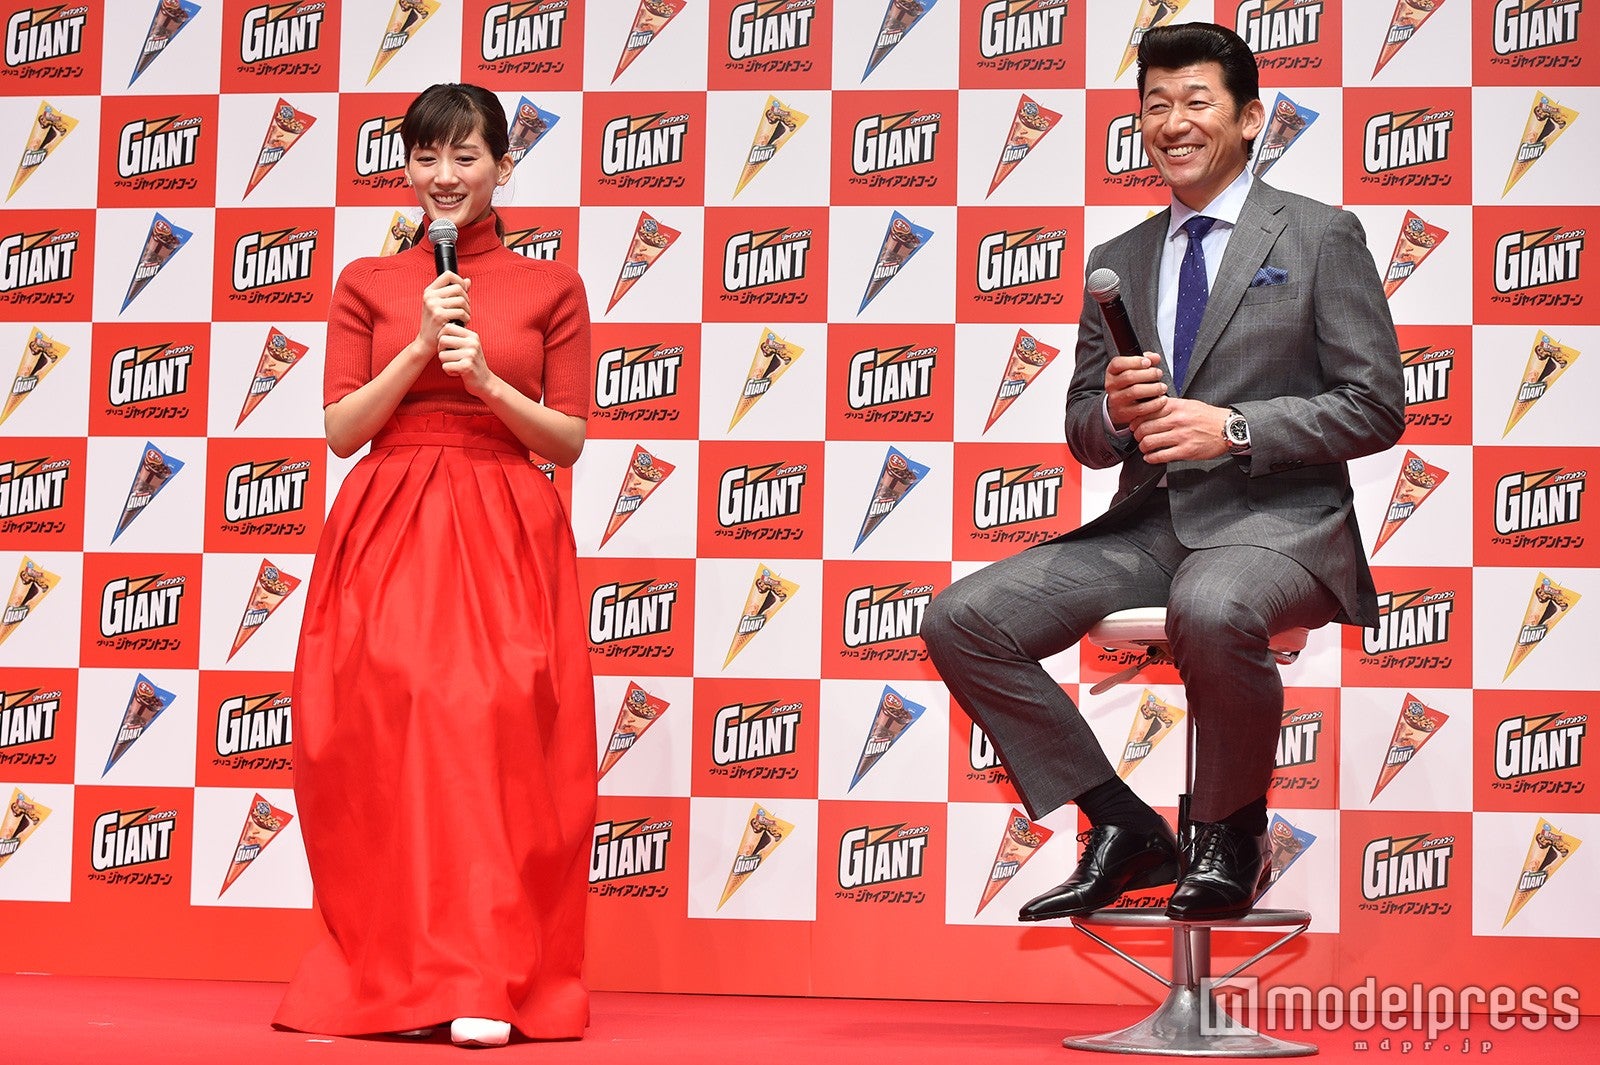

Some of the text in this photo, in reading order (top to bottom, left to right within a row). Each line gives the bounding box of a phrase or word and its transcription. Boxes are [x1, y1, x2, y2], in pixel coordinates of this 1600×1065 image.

[6, 10, 85, 66] GIANT
[242, 6, 322, 63] GIANT
[482, 4, 565, 60] GIANT
[730, 2, 813, 59] GIANT
[981, 0, 1066, 58] GIANT
[1494, 0, 1580, 54] GIANT
[20, 67, 83, 79] ジャイアントコーン
[256, 64, 321, 76] ジャイアントコーン
[498, 62, 564, 74] ジャイアントコーン
[745, 60, 812, 72] ジャイアントコーン
[997, 59, 1066, 71] ジャイアントコーン
[1511, 55, 1581, 68] ジャイアントコーン
[118, 121, 199, 177] GIANT
[357, 119, 406, 176] GIA
[602, 117, 686, 175] GIANT
[853, 116, 938, 174] GIANT
[1365, 114, 1451, 173] GIANT
[133, 178, 197, 190] ジャイアントコーン
[618, 176, 685, 188] ジャイアントコーン
[869, 175, 937, 188] ジャイアントコーン
[1381, 174, 1451, 186] ジャイアントコーン
[0, 235, 76, 292] GIANT
[233, 233, 315, 290] GIANT
[724, 233, 809, 291] GIANT
[978, 233, 1064, 291] GIANT
[1495, 233, 1582, 292] GIANT
[10, 292, 74, 304] ジャイアントコーン
[248, 292, 313, 304] ジャイアントコーン
[740, 292, 808, 304] ジャイアントコーン
[994, 292, 1063, 305] ジャイアントコーン
[1512, 293, 1583, 306] ジャイアントコーン
[110, 348, 191, 405] GIANT
[596, 349, 680, 407] GIANT
[849, 350, 934, 409] GIANT
[1403, 360, 1450, 404] ANT
[124, 406, 189, 419] ジャイアントコーン
[612, 408, 679, 421] ジャイアントコーン
[865, 410, 934, 422] ジャイアントコーン
[1405, 414, 1452, 426] アントコーン
[225, 464, 307, 522] GIANT
[719, 467, 804, 526] GIANT
[975, 469, 1061, 529] GIANT
[1496, 474, 1583, 534] GIANT
[1, 521, 65, 533] ジャイアントコーン
[240, 523, 306, 535] ジャイアントコーン
[735, 527, 803, 540] ジャイアントコーン
[1513, 535, 1584, 548] ジャイアントコーン
[101, 579, 182, 636] GIANT
[590, 584, 675, 643] GIANT
[844, 587, 930, 647] GIANT
[116, 638, 181, 650] ジャイアントコーン
[606, 645, 674, 657] ジャイアントコーン
[860, 648, 929, 661] ジャイアントコーン
[1381, 656, 1451, 669] ジャイアントコーン
[0, 701, 57, 746] IANT
[714, 705, 799, 765] GIANT
[1496, 718, 1584, 778] GIANT
[729, 766, 798, 779] ジャイアントコーン
[1513, 780, 1584, 793] ジャイアントコーン
[92, 812, 174, 870] GIANT
[588, 823, 668, 882] GIANT
[839, 828, 926, 888] GIANT
[107, 872, 172, 885] ジャイアントコーン
[600, 884, 668, 897] ジャイアントコーン
[1363, 838, 1451, 900] GIANT
[855, 890, 925, 903] ジャイアントコーン
[1380, 901, 1451, 914] ジャイアントコーン
